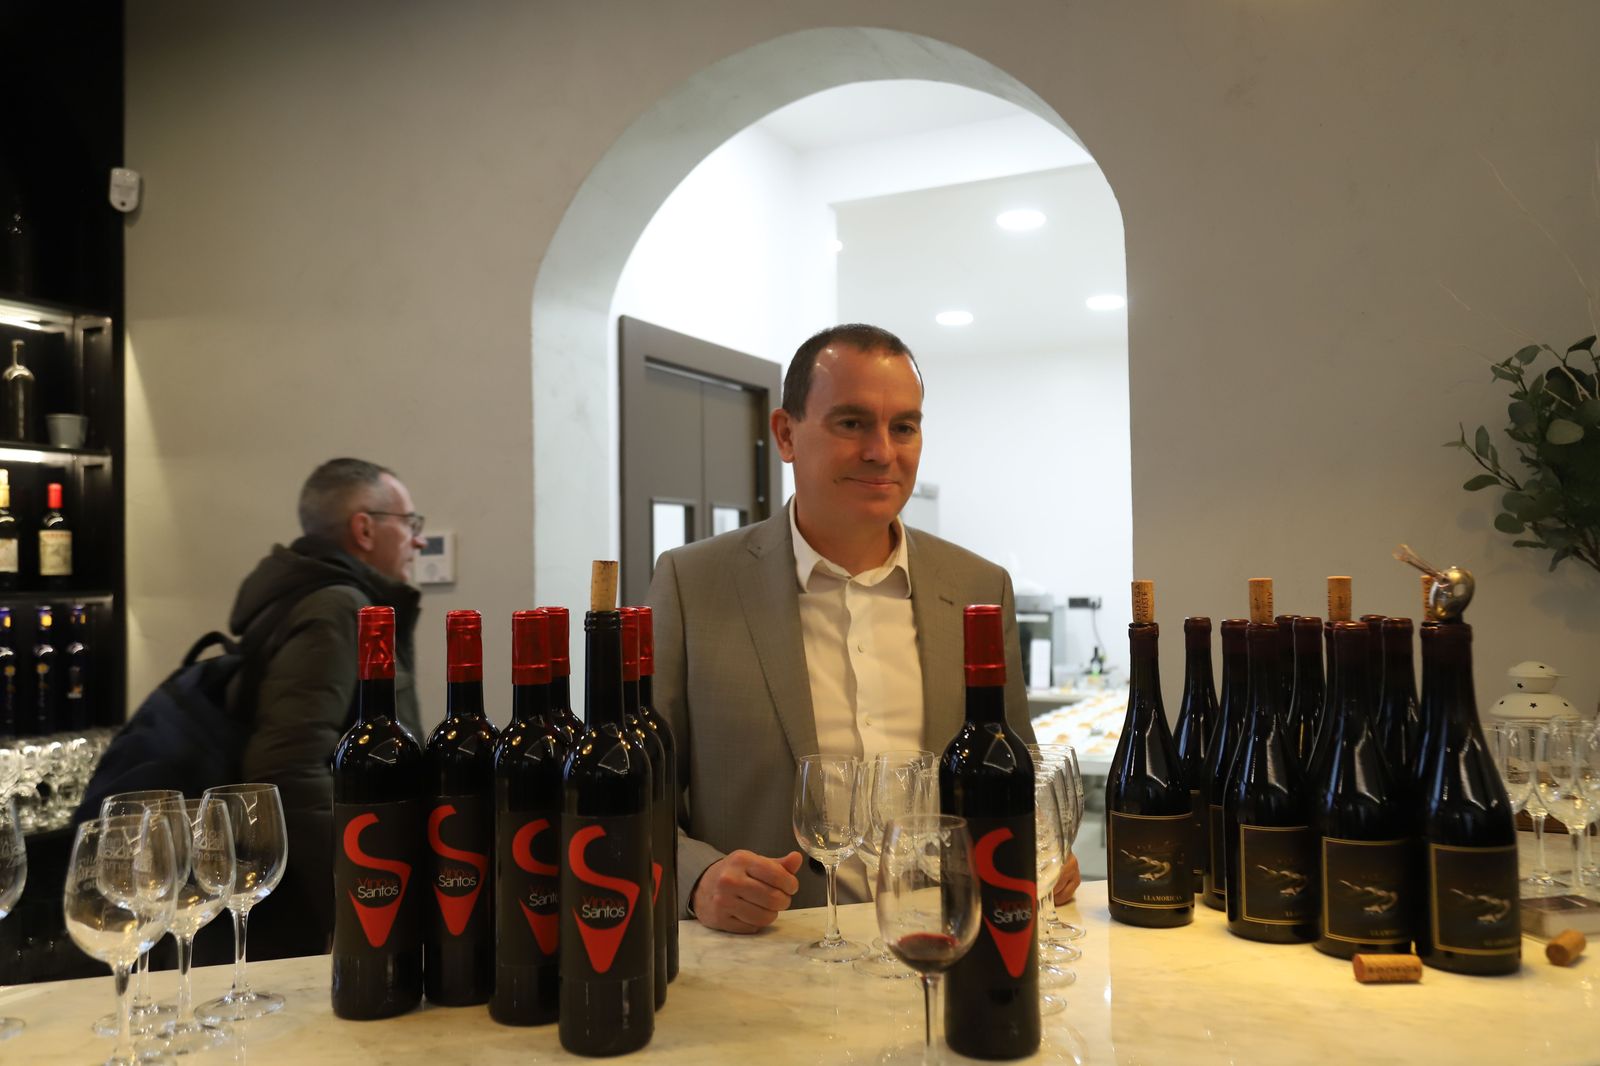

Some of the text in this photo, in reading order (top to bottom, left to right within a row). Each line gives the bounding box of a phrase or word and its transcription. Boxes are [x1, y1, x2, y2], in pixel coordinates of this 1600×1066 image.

[438, 874, 477, 888] Santos
[357, 885, 399, 899] Santos
[529, 892, 559, 907] Sant
[582, 904, 626, 919] Santos
[993, 909, 1032, 924] Santos
